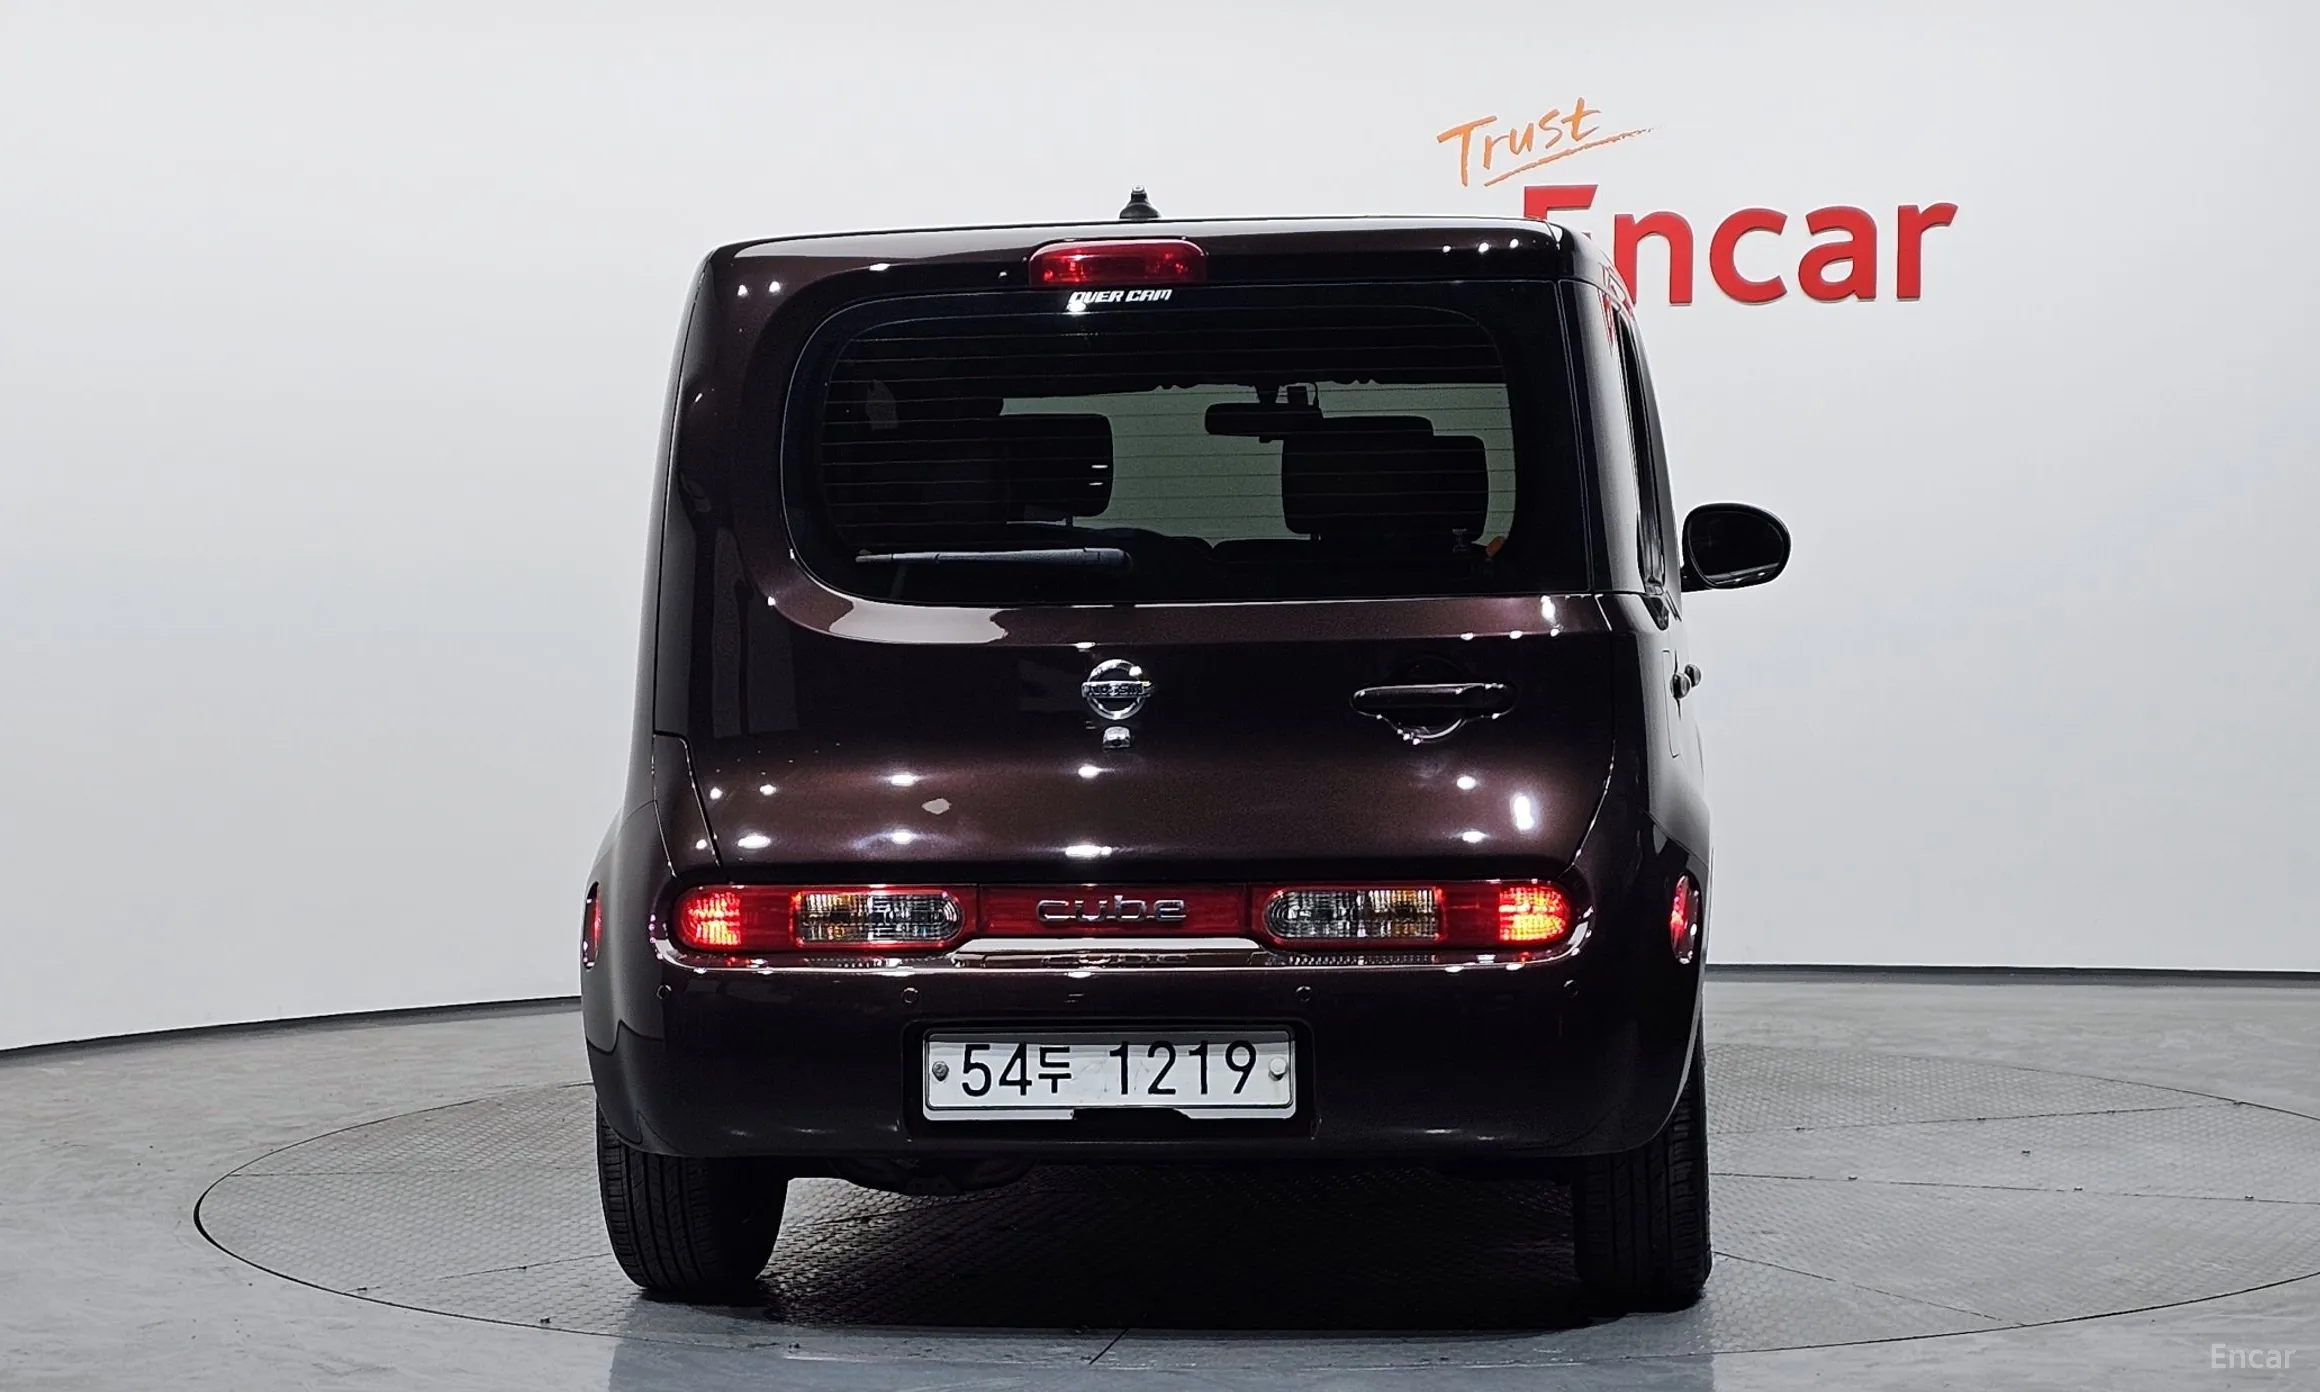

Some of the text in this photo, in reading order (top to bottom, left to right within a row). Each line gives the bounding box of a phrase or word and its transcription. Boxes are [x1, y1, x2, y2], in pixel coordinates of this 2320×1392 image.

[1437, 97, 1601, 187] Trust
[1125, 289, 1173, 302] CAM
[1037, 895, 1187, 922] cube
[962, 1040, 1257, 1097] 54두 1219
